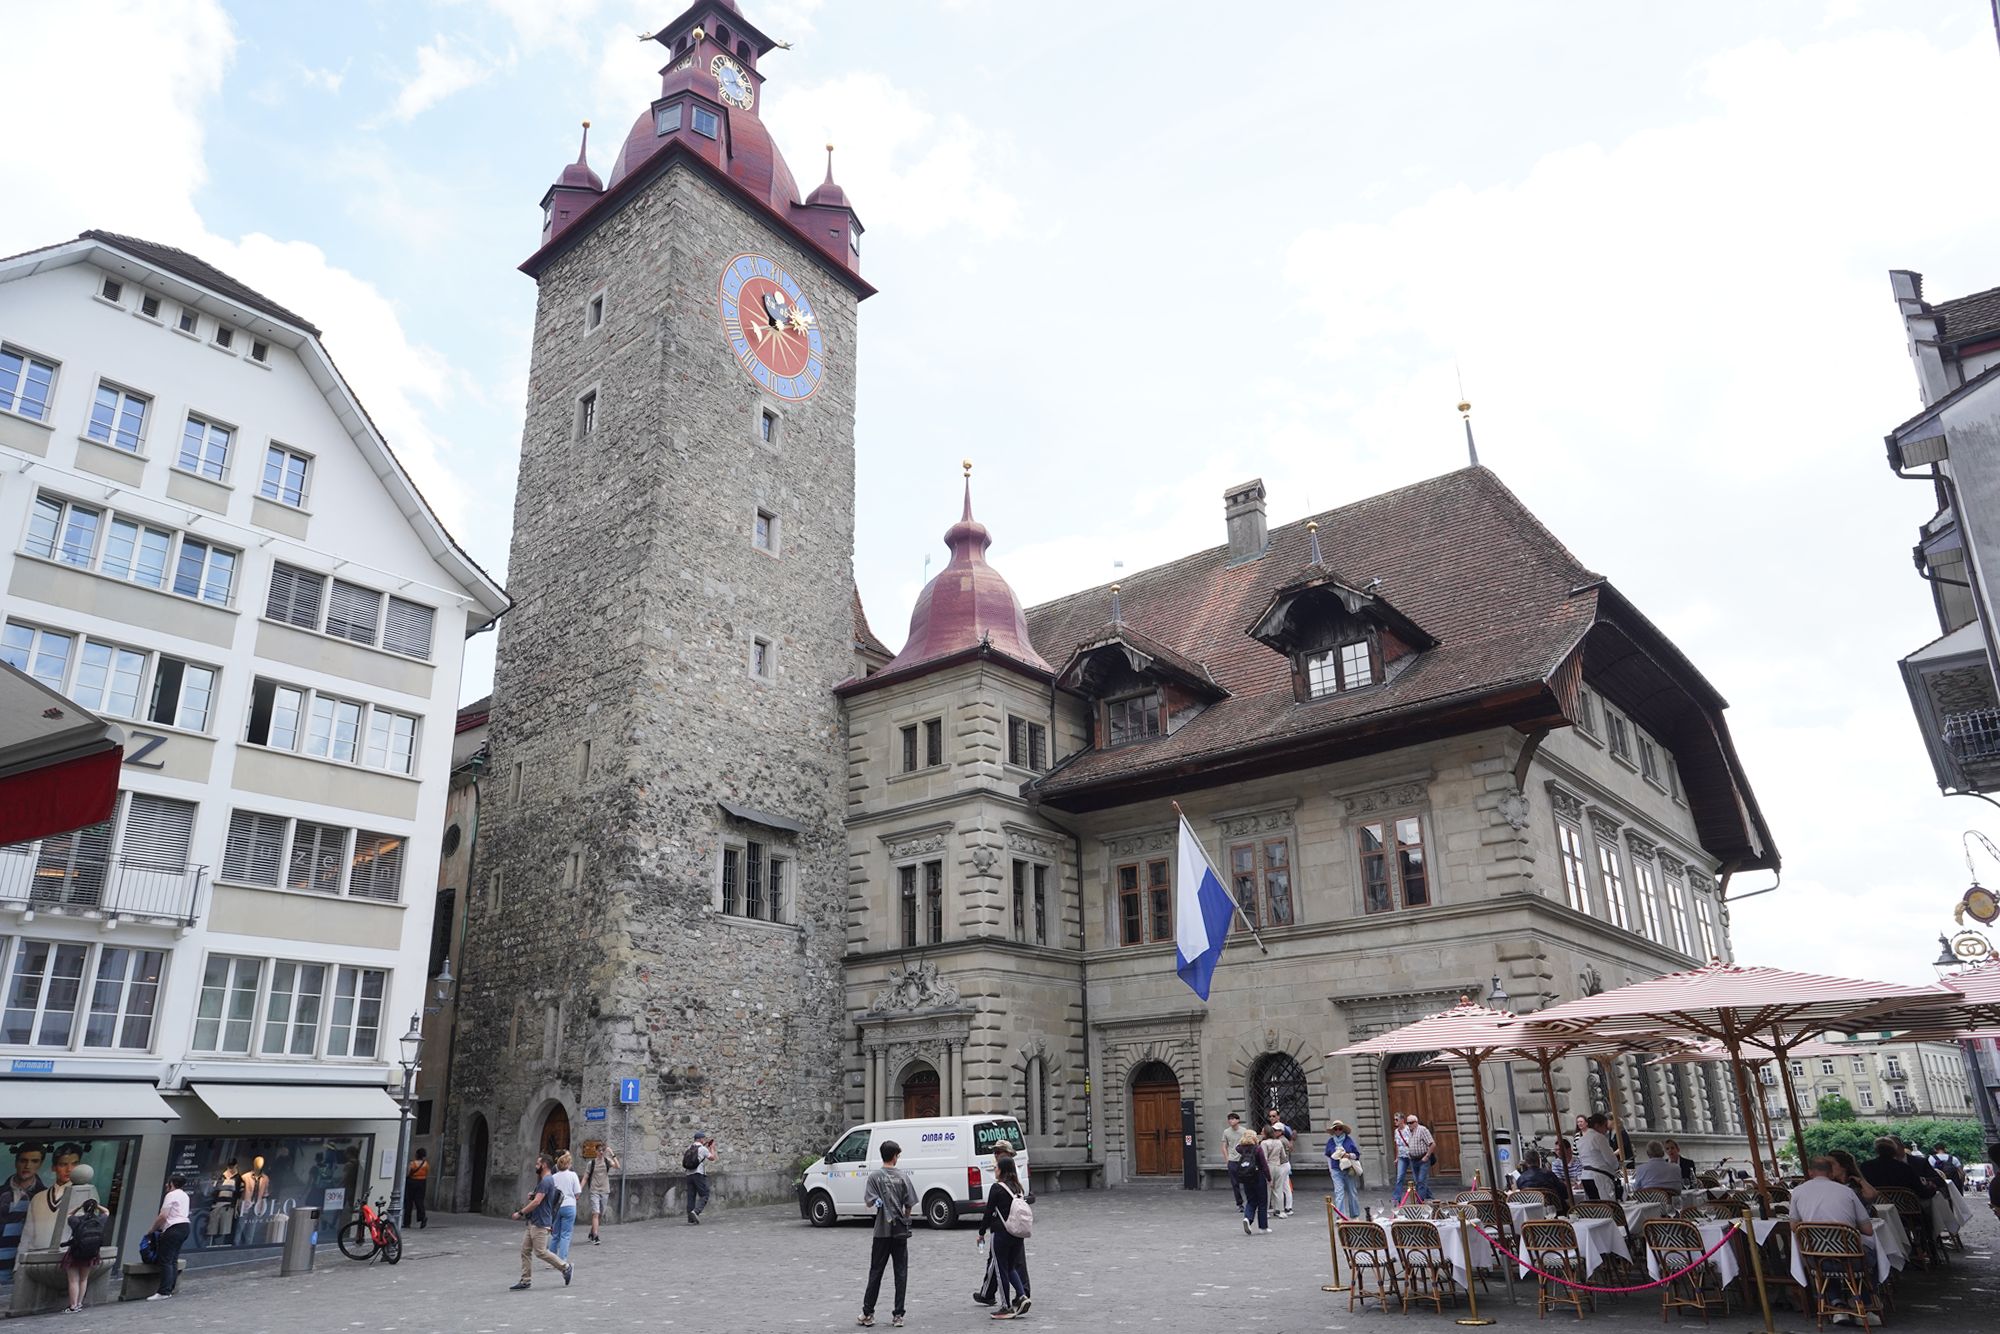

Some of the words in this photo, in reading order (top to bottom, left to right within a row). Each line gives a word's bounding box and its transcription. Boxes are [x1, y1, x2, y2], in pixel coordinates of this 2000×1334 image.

[122, 730, 168, 770] Z
[15, 1060, 52, 1069] Kornmarkt
[921, 1133, 943, 1142] DINBA
[944, 1132, 956, 1141] AG
[978, 1127, 1007, 1142] DINBA
[1007, 1126, 1020, 1139] AG
[240, 1198, 297, 1217] POLO
